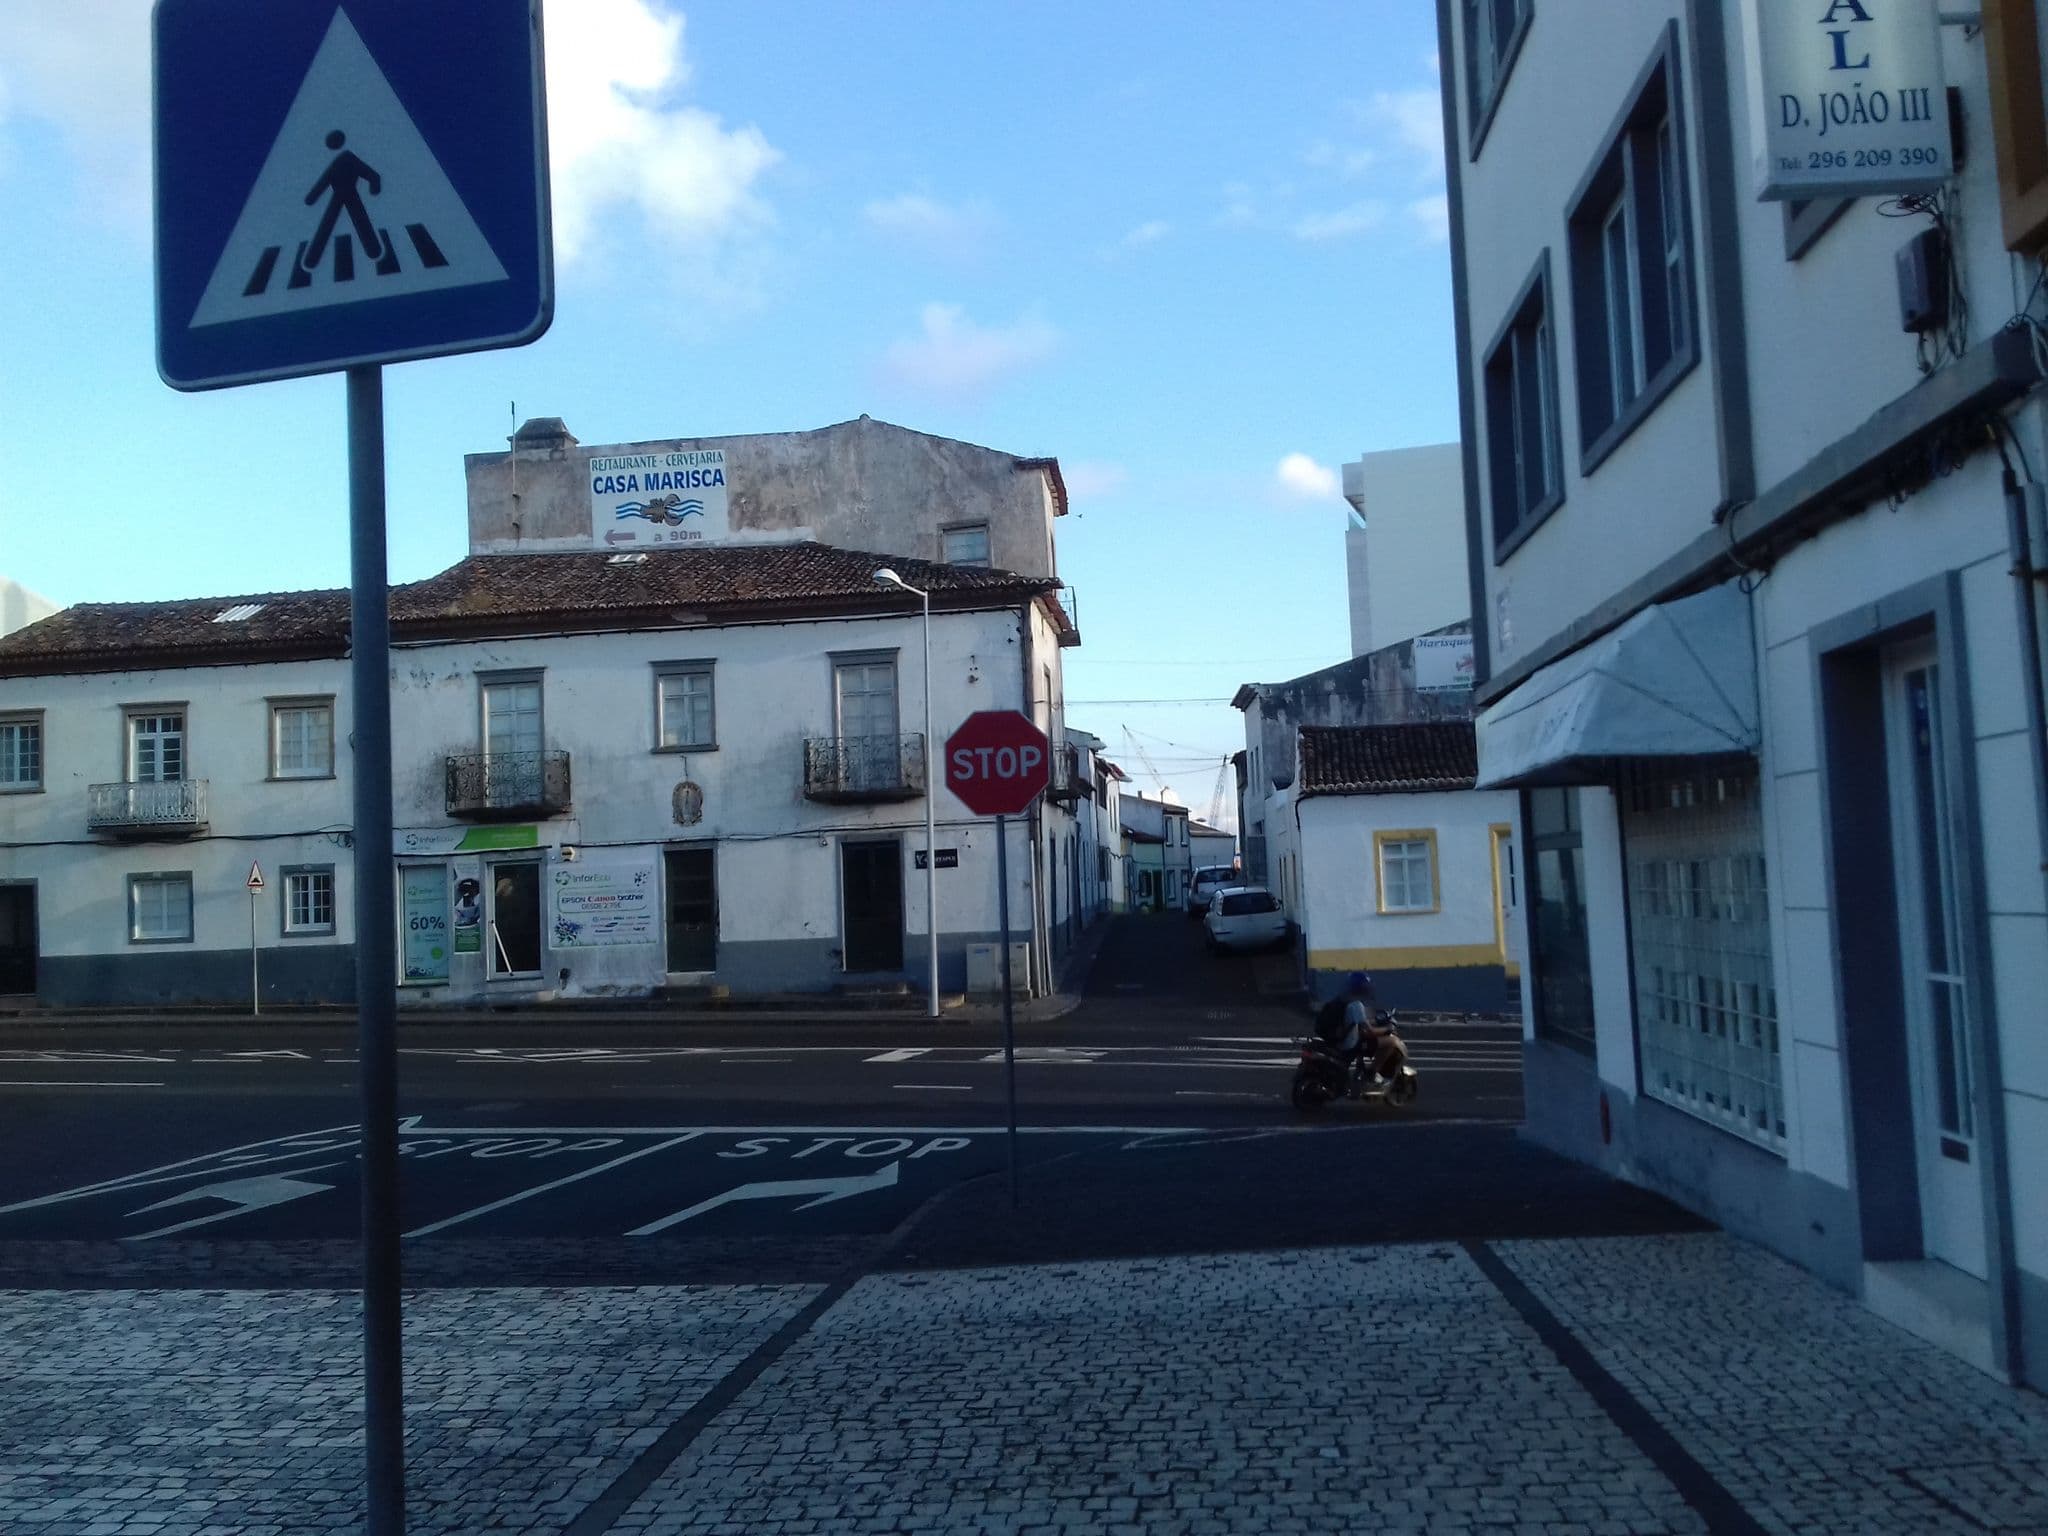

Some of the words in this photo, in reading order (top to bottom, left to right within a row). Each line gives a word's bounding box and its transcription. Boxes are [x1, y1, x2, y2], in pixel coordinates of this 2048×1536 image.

[1780, 94, 1810, 128] D.
[1818, 82, 1889, 136] JOÃO
[1898, 87, 1932, 121] III
[1809, 151, 1847, 169] 296
[1854, 149, 1892, 167] 209
[1900, 147, 1939, 165] 390
[592, 455, 657, 471] RESTAURANTE
[666, 451, 724, 468] CERVEJARIA
[593, 474, 639, 494] CASA
[645, 469, 725, 491] MARISCA
[654, 533, 662, 542] a
[670, 530, 702, 541] 90m
[953, 745, 1041, 780] STOP
[410, 916, 445, 930] 60%
[716, 1138, 971, 1158] STOP
